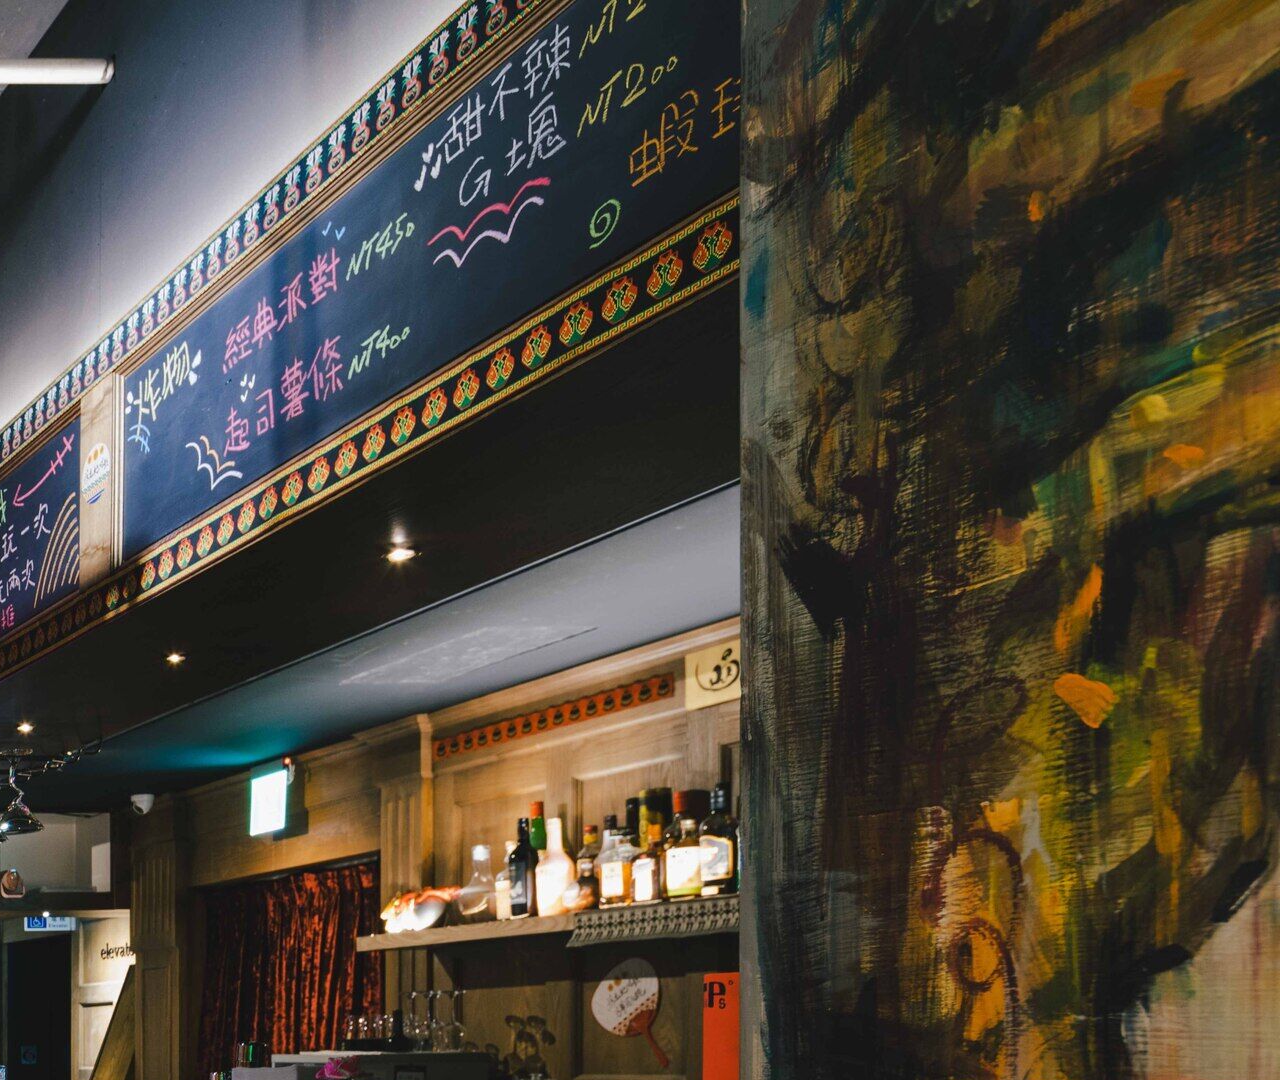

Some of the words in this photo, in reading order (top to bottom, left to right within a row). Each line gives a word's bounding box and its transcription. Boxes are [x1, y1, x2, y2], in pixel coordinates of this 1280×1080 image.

[437, 24, 571, 164] 甜不辣
[576, 55, 679, 138] NT200
[222, 247, 341, 375] 經典派對
[345, 211, 415, 282] NT450
[133, 340, 192, 443] 炸物
[223, 335, 344, 458] 起司薯條
[346, 324, 410, 380] NT400
